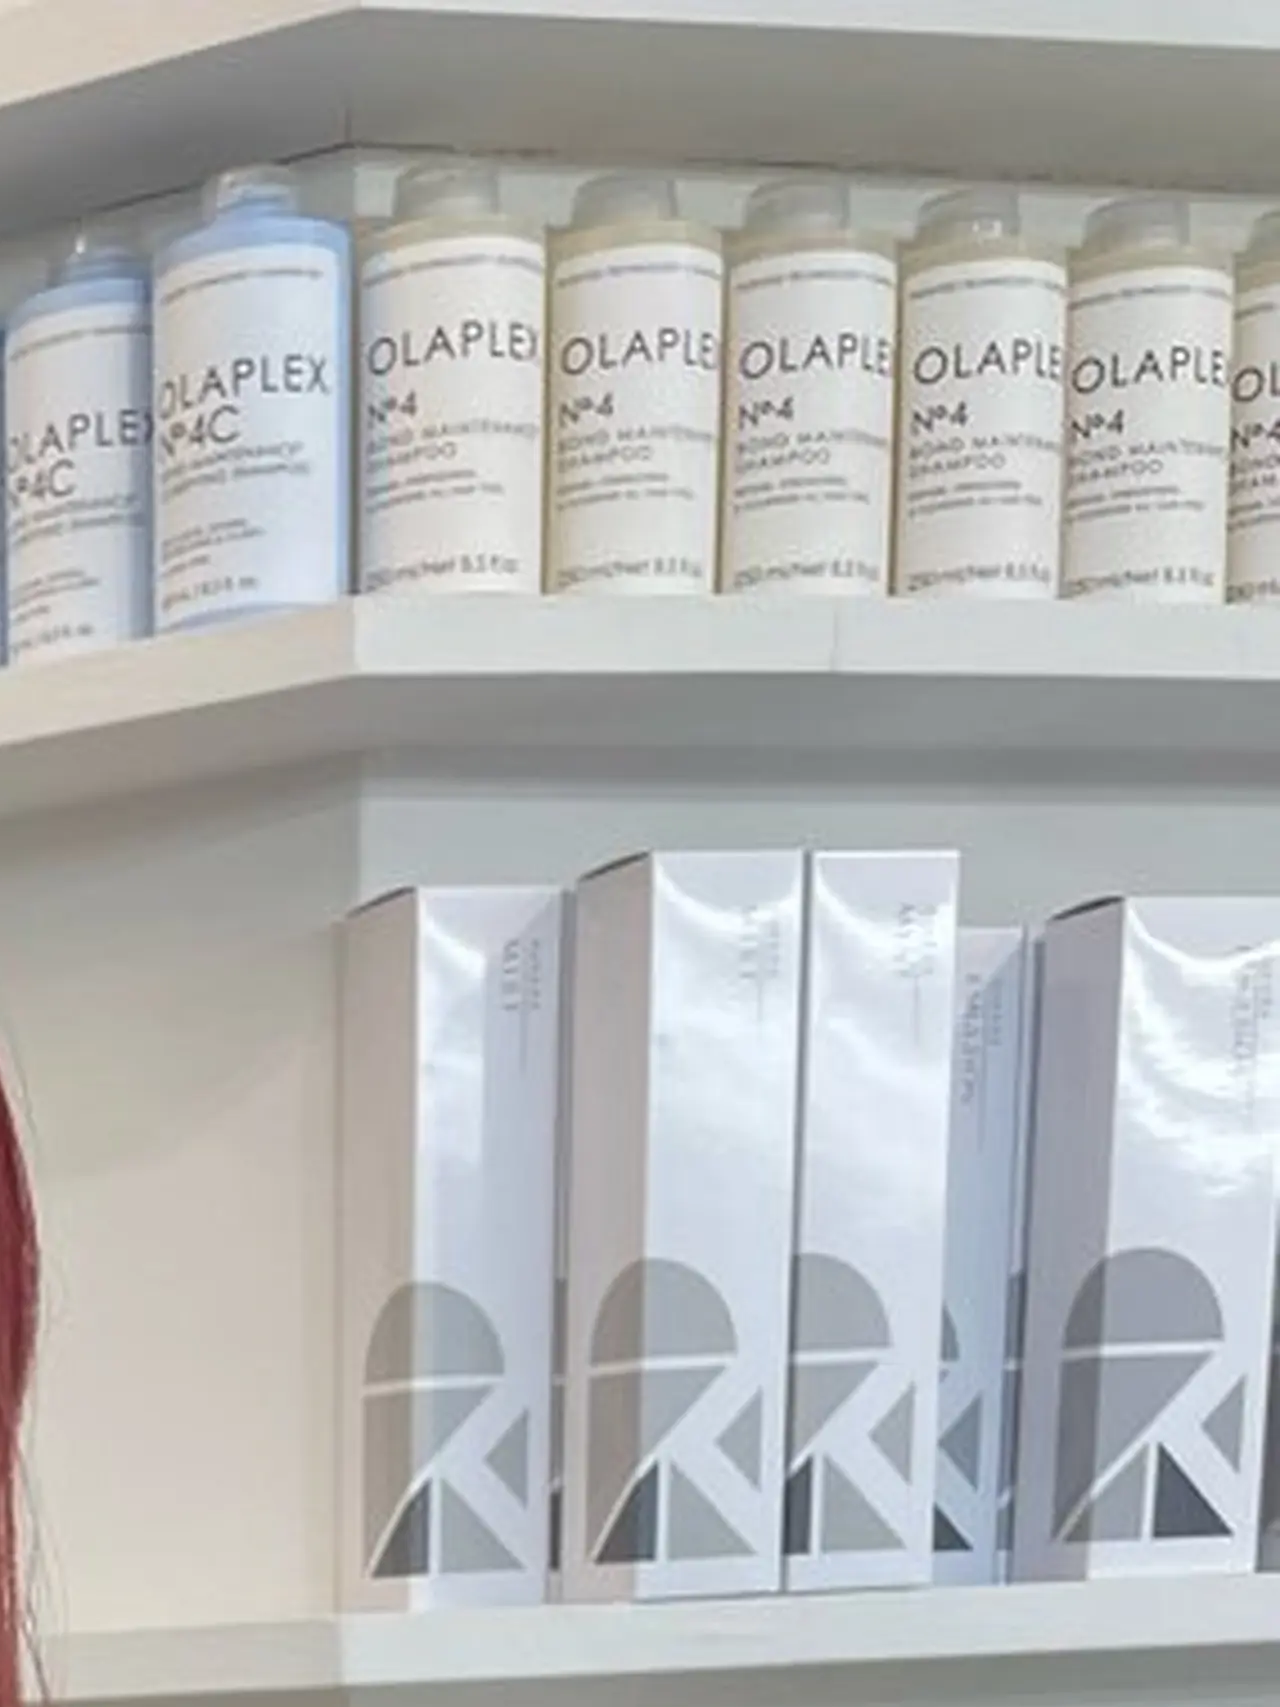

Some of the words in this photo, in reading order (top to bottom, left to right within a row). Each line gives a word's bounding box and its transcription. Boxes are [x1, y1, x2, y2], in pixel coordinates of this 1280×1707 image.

[561, 326, 718, 376] OLAPLE
[739, 332, 891, 380] OLAPLE
[913, 337, 1062, 386] OLAPLE
[1071, 346, 1225, 395] OLAPLE
[159, 354, 330, 420] OLAPLEX
[1232, 361, 1280, 403] OL
